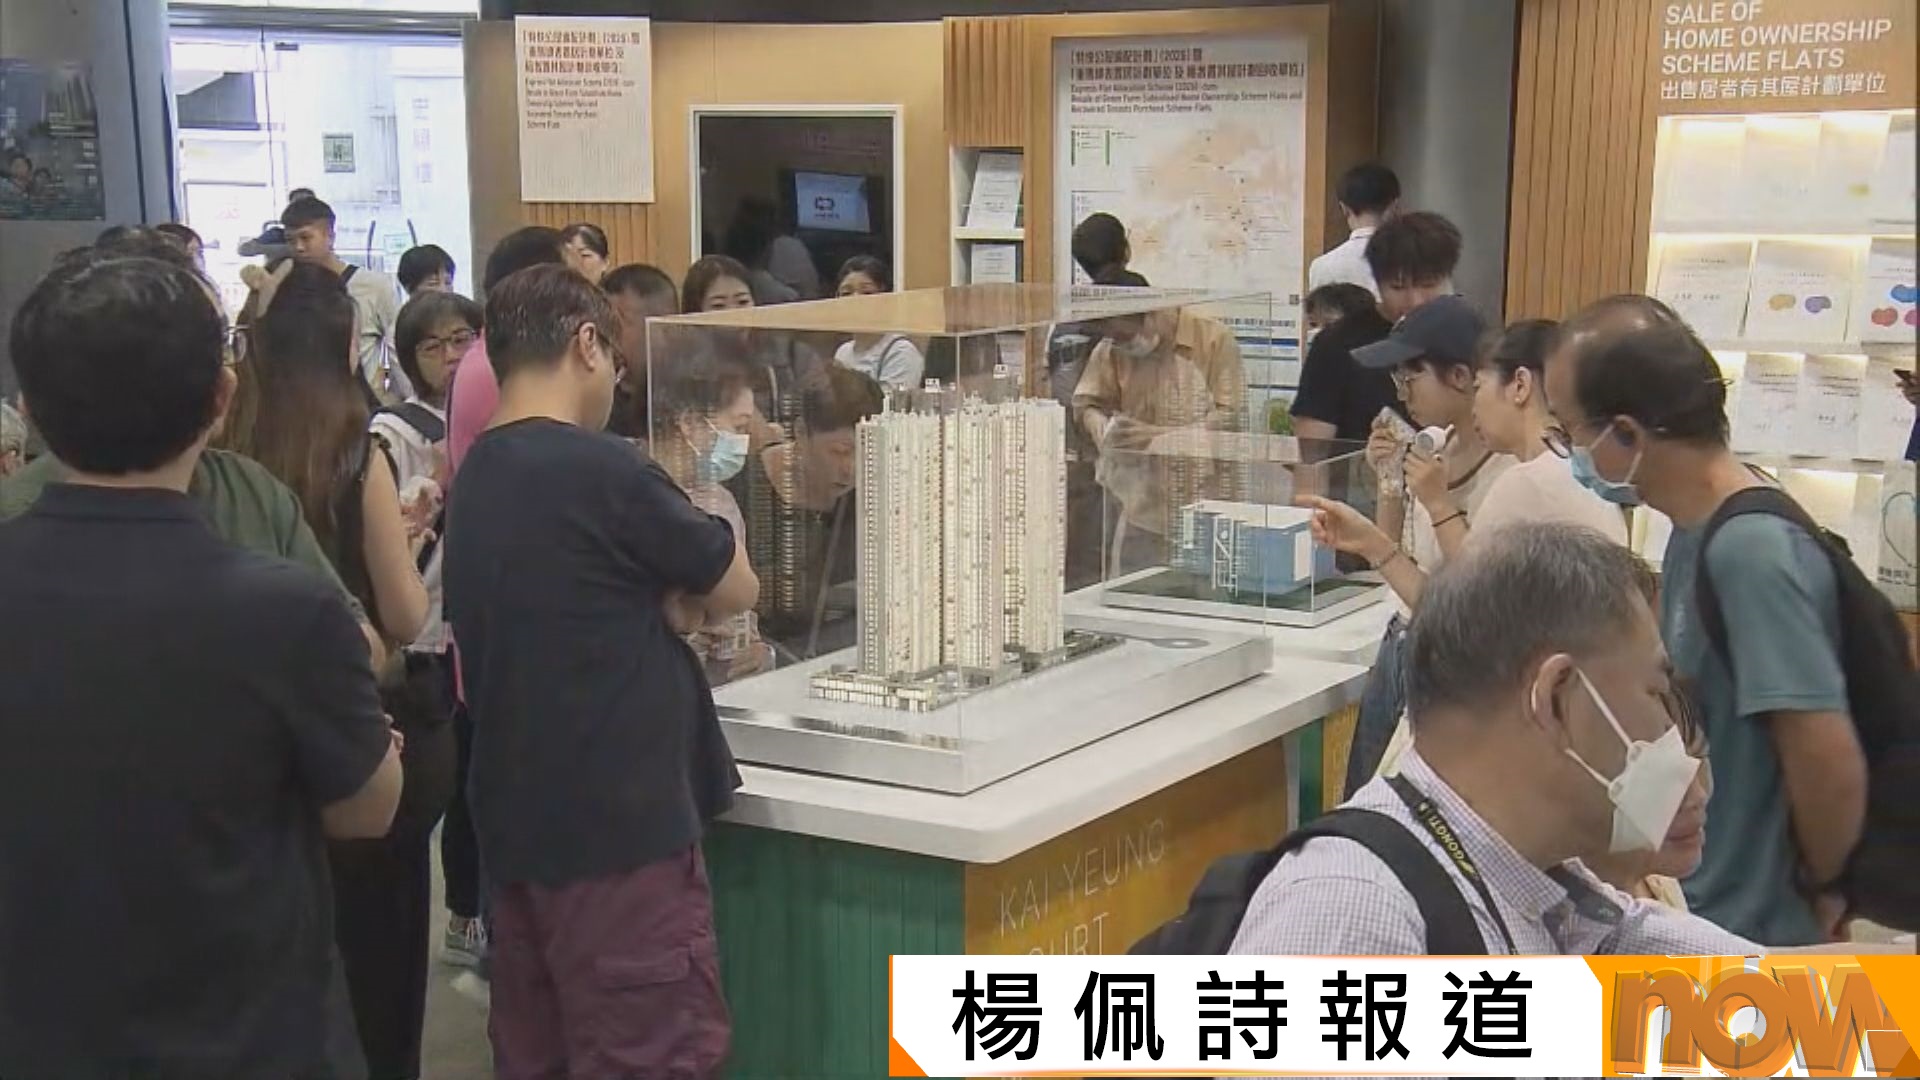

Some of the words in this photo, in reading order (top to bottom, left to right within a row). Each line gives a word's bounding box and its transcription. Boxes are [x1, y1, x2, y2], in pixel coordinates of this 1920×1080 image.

[1665, 2, 1725, 25] SALE
[1731, 0, 1763, 22] OF
[1663, 27, 1735, 49] HOME
[1740, 18, 1893, 47] OWNERSHIP
[1661, 51, 1761, 75] SCHEME
[1767, 47, 1846, 71] FLATS
[1660, 71, 1887, 100] 出售居者有其屋計劃單位
[1000, 871, 1048, 937] KAI
[1063, 817, 1166, 905] YEUNG
